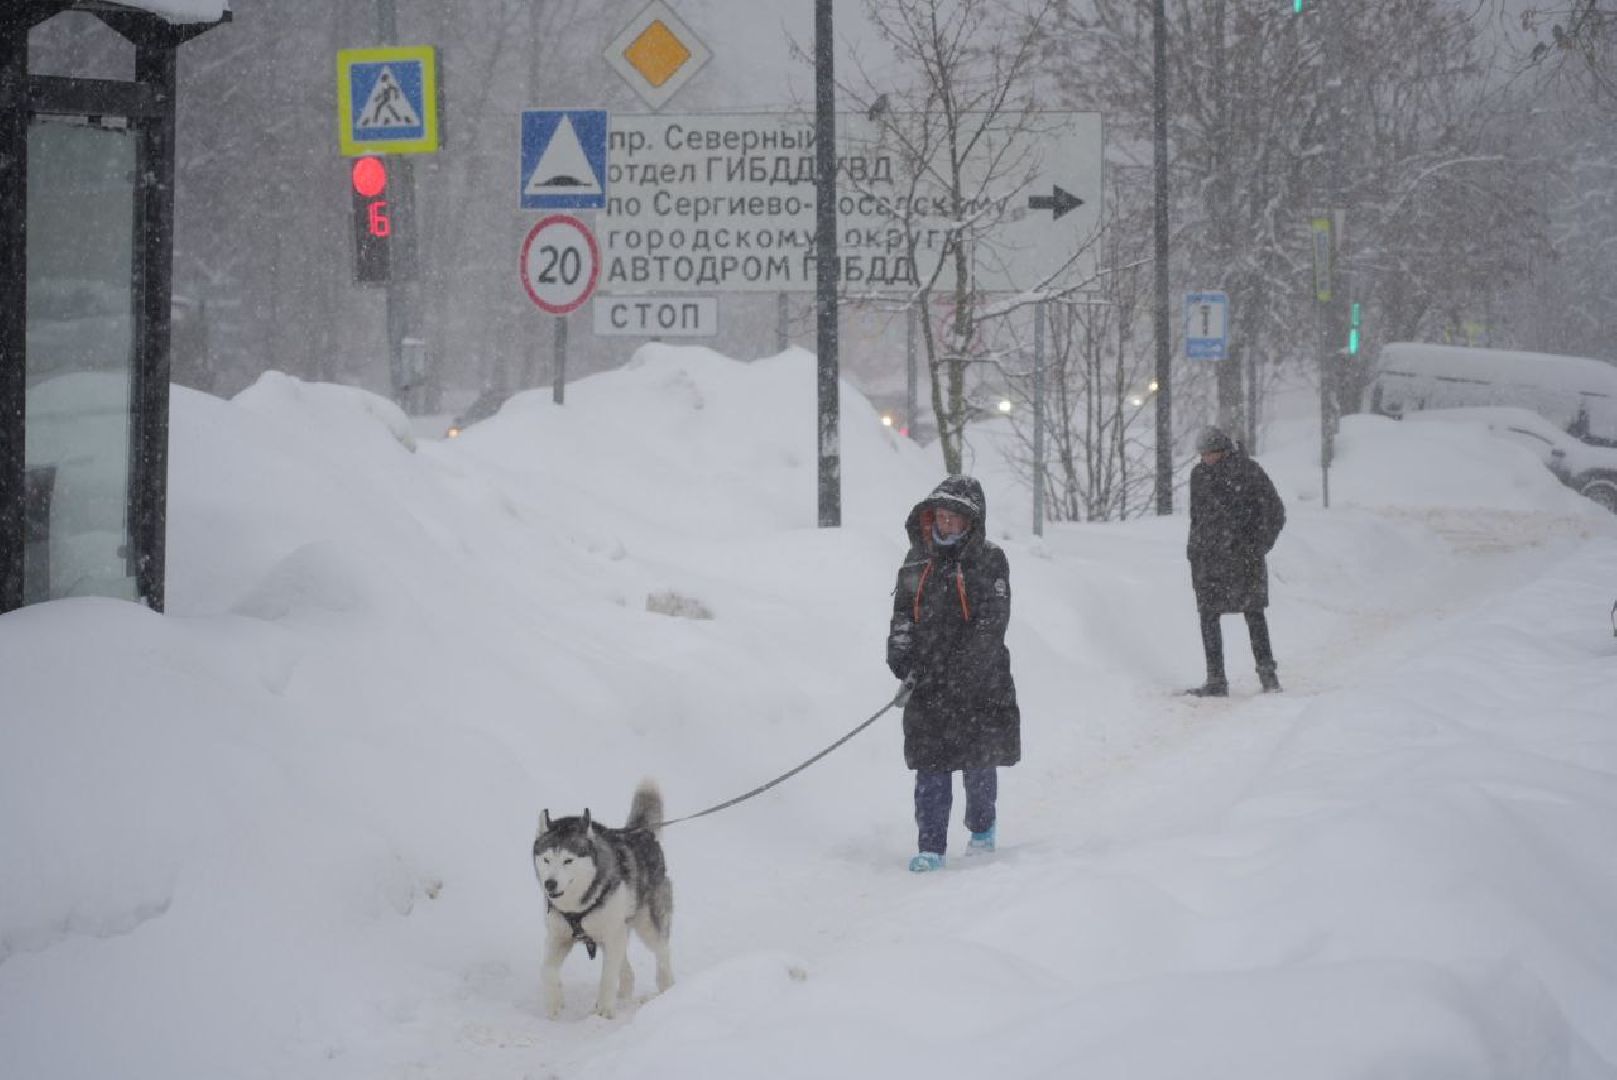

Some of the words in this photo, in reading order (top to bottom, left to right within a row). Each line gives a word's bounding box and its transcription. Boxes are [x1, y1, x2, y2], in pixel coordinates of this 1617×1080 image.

[609, 130, 653, 157] пр.
[608, 163, 697, 186] отдел
[706, 156, 818, 186] ГИБДД
[606, 196, 641, 217] по
[609, 228, 818, 256] городскому
[537, 246, 582, 285] 20
[608, 256, 791, 286] АВТОДРОМ
[802, 255, 914, 286] ГБДД
[611, 303, 699, 329] СТОП
